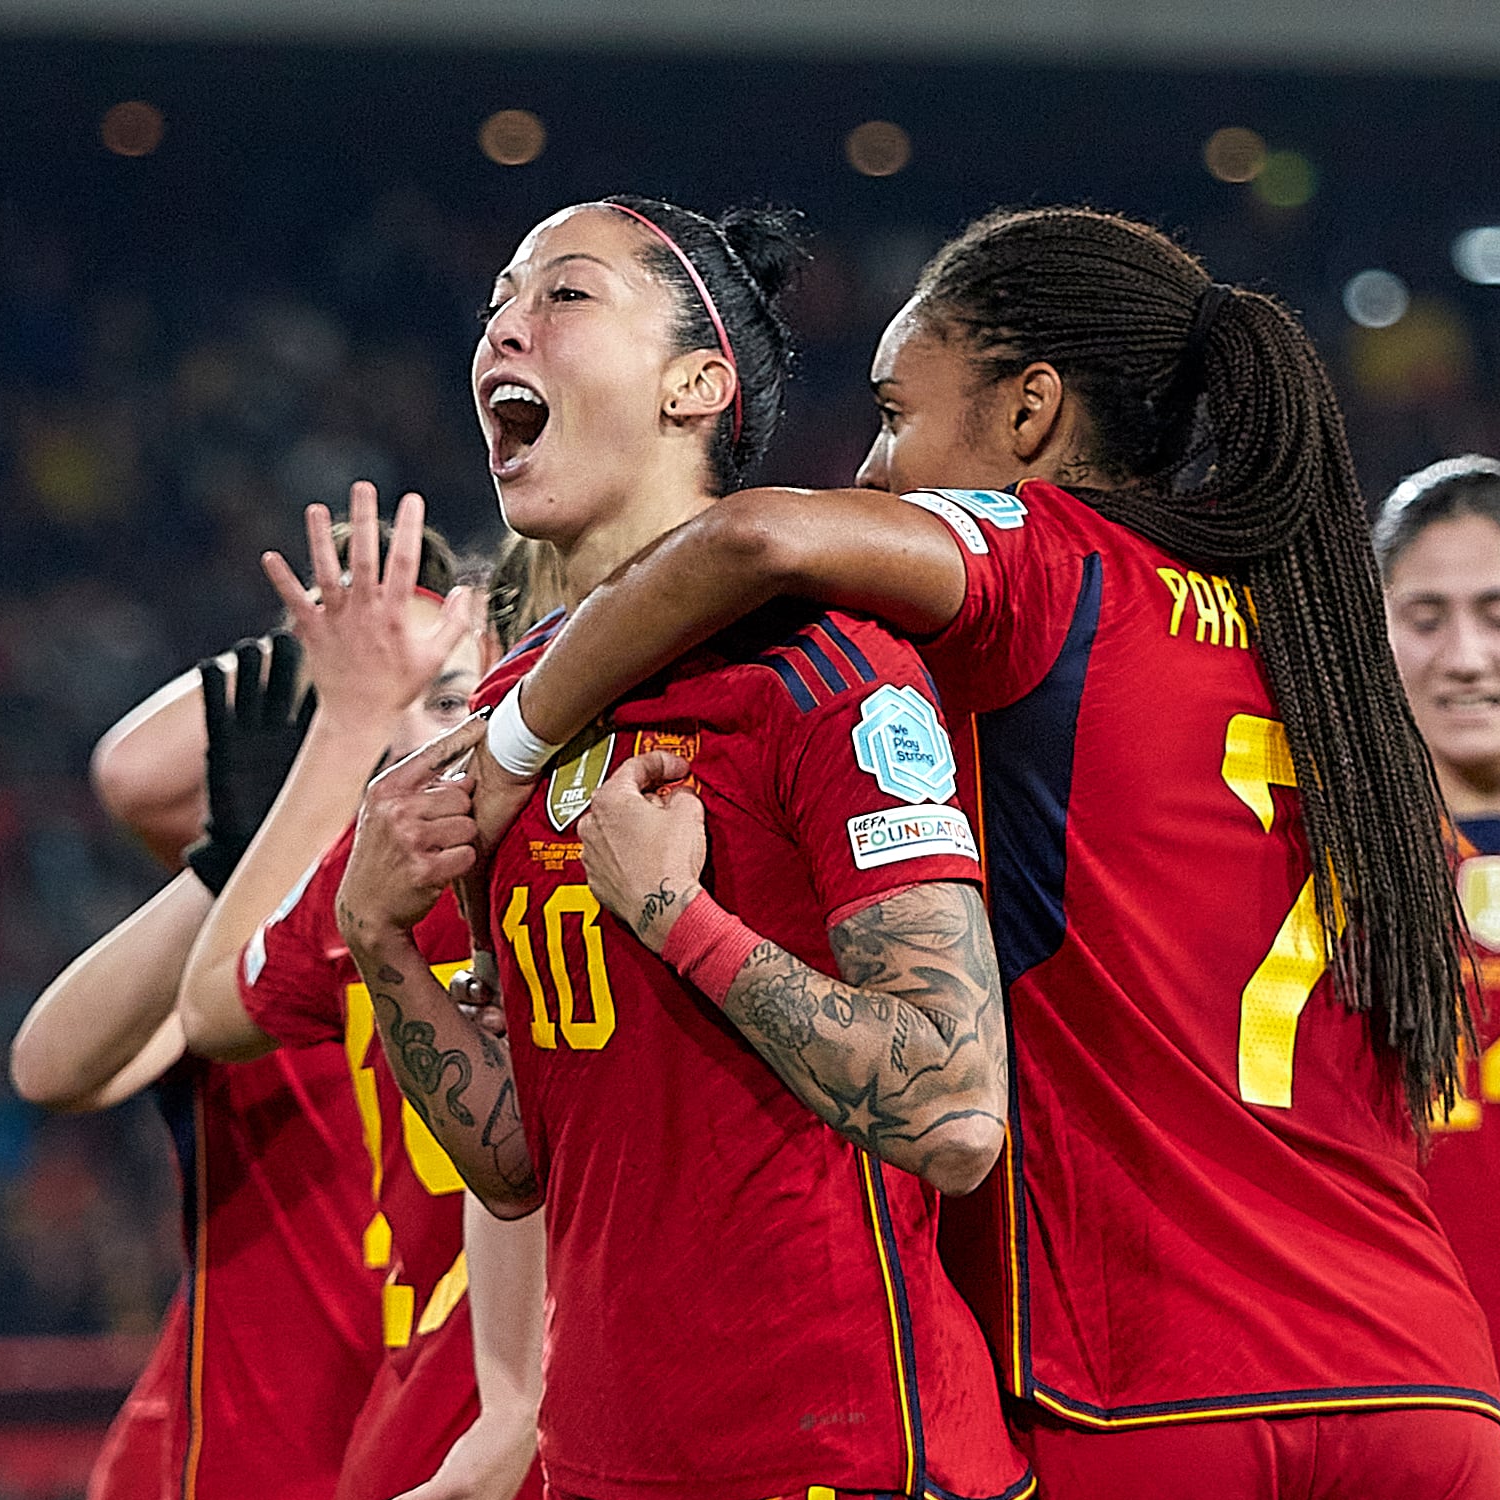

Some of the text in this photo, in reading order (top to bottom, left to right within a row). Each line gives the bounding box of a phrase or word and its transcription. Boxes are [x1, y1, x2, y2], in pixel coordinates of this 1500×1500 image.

[1156, 567, 1261, 649] PAR
[889, 723, 909, 736] We
[893, 737, 920, 752] Play
[897, 750, 936, 767] Strong
[560, 787, 587, 803] FIFA
[853, 815, 887, 833] UEFA
[1221, 713, 1348, 1108] 7
[502, 884, 616, 1050] 10
